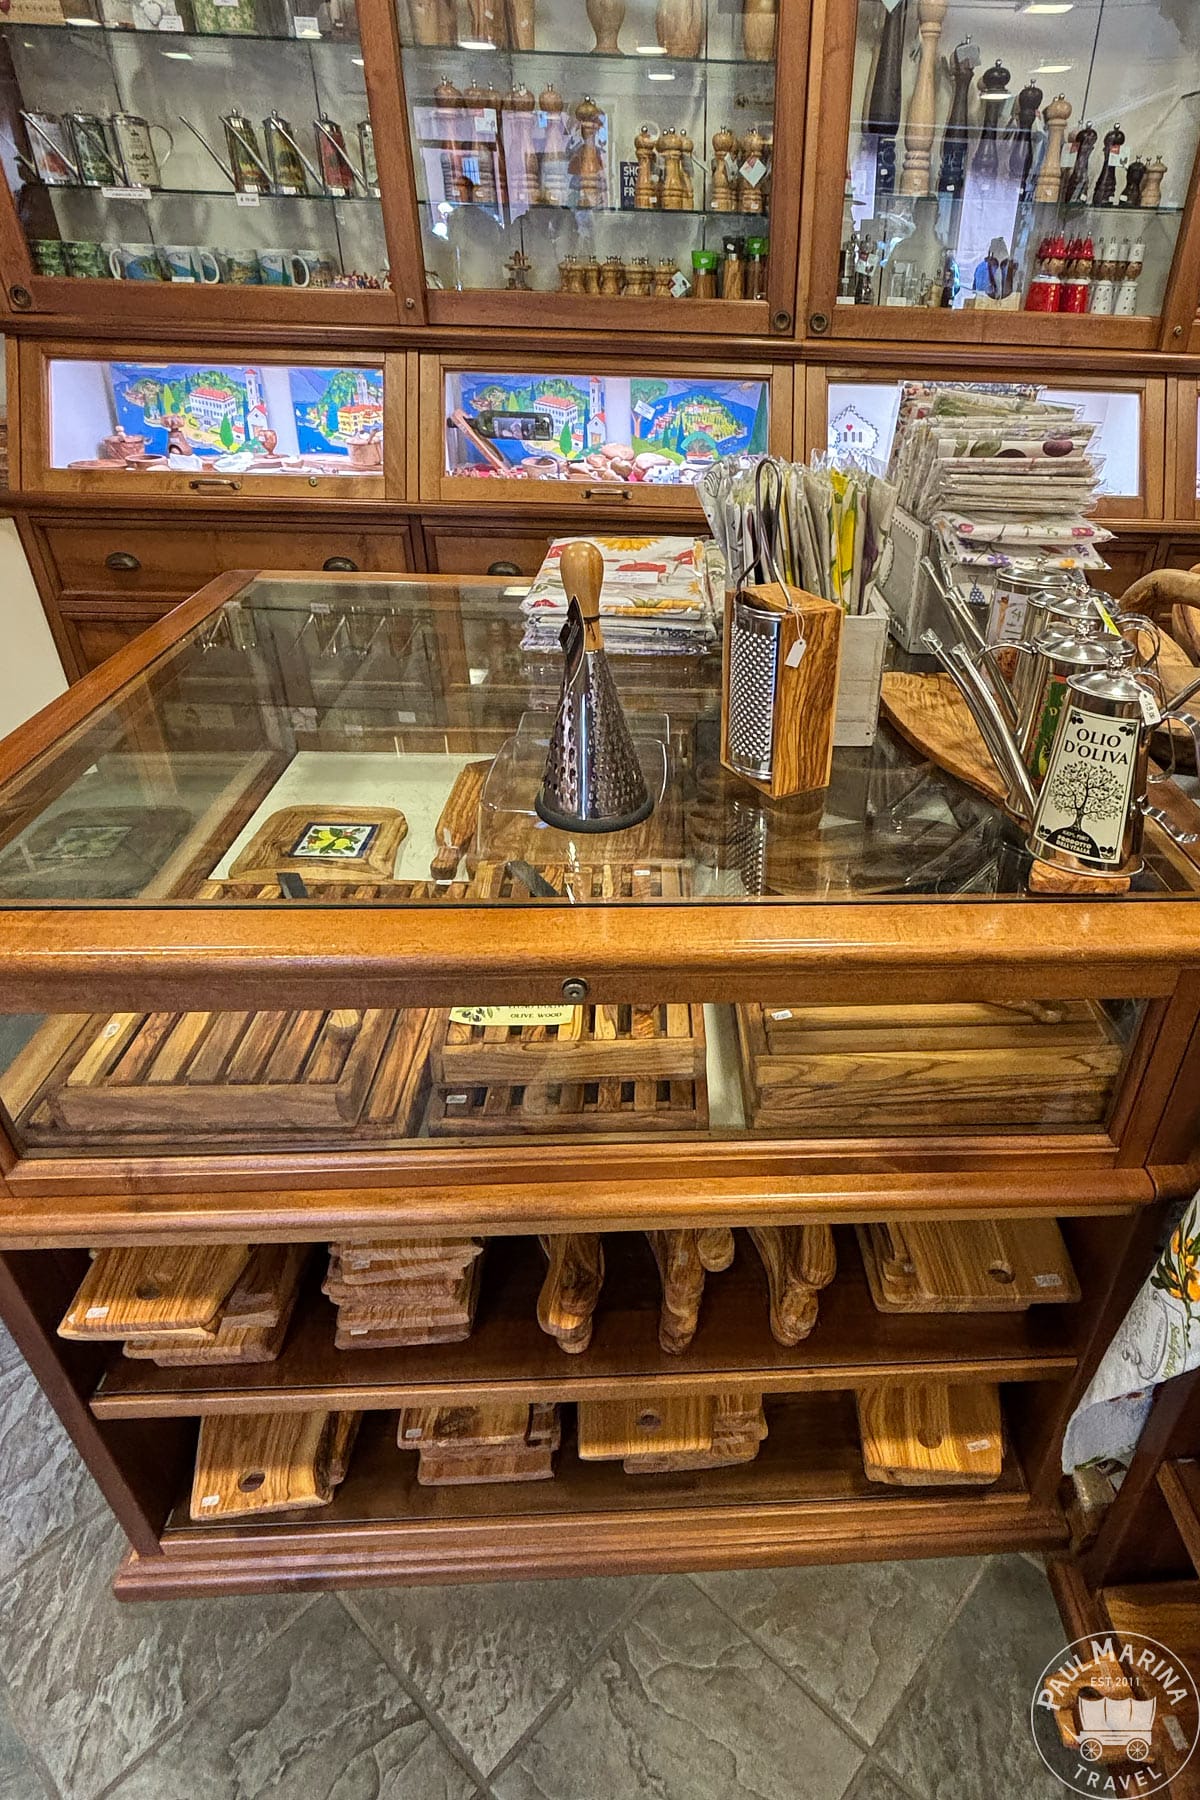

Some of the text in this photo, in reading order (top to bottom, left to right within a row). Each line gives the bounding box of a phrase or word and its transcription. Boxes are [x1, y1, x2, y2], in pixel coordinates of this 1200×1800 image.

[1076, 728, 1122, 748] OLIO
[1063, 739, 1128, 765] D'OLIVA
[1057, 834, 1092, 849] PRODOTTO
